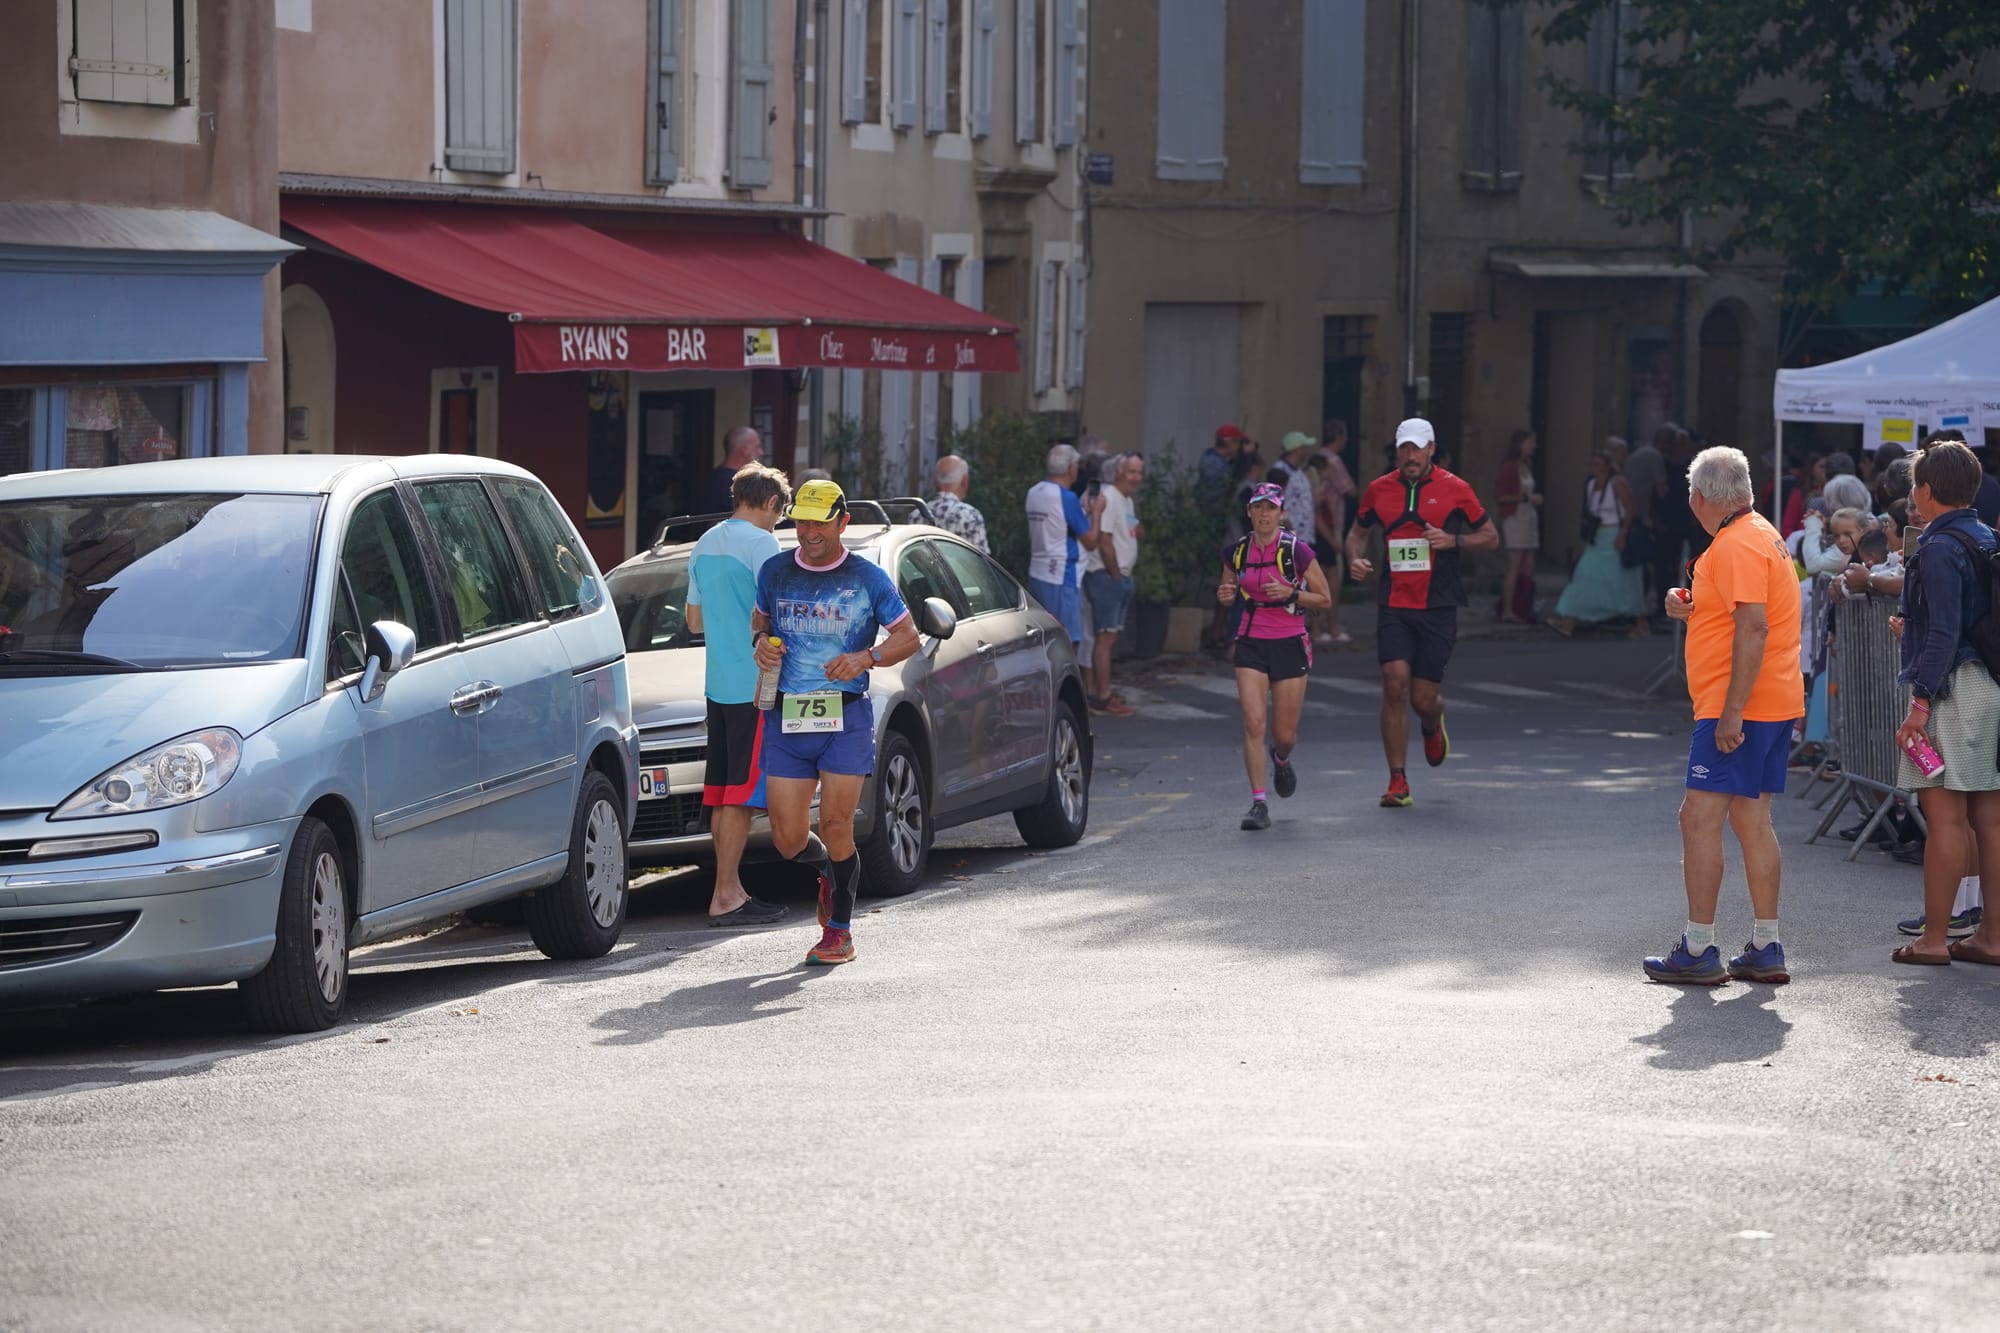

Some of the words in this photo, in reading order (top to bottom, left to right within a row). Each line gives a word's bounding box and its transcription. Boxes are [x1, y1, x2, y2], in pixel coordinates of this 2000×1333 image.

[560, 326, 628, 362] RYAN'S
[667, 328, 707, 362] BAR
[820, 331, 844, 360] Chez
[926, 344, 935, 364] et
[1398, 547, 1418, 560] 15
[778, 600, 850, 621] TRAIL
[796, 699, 827, 717] 75
[655, 783, 666, 793] 48
